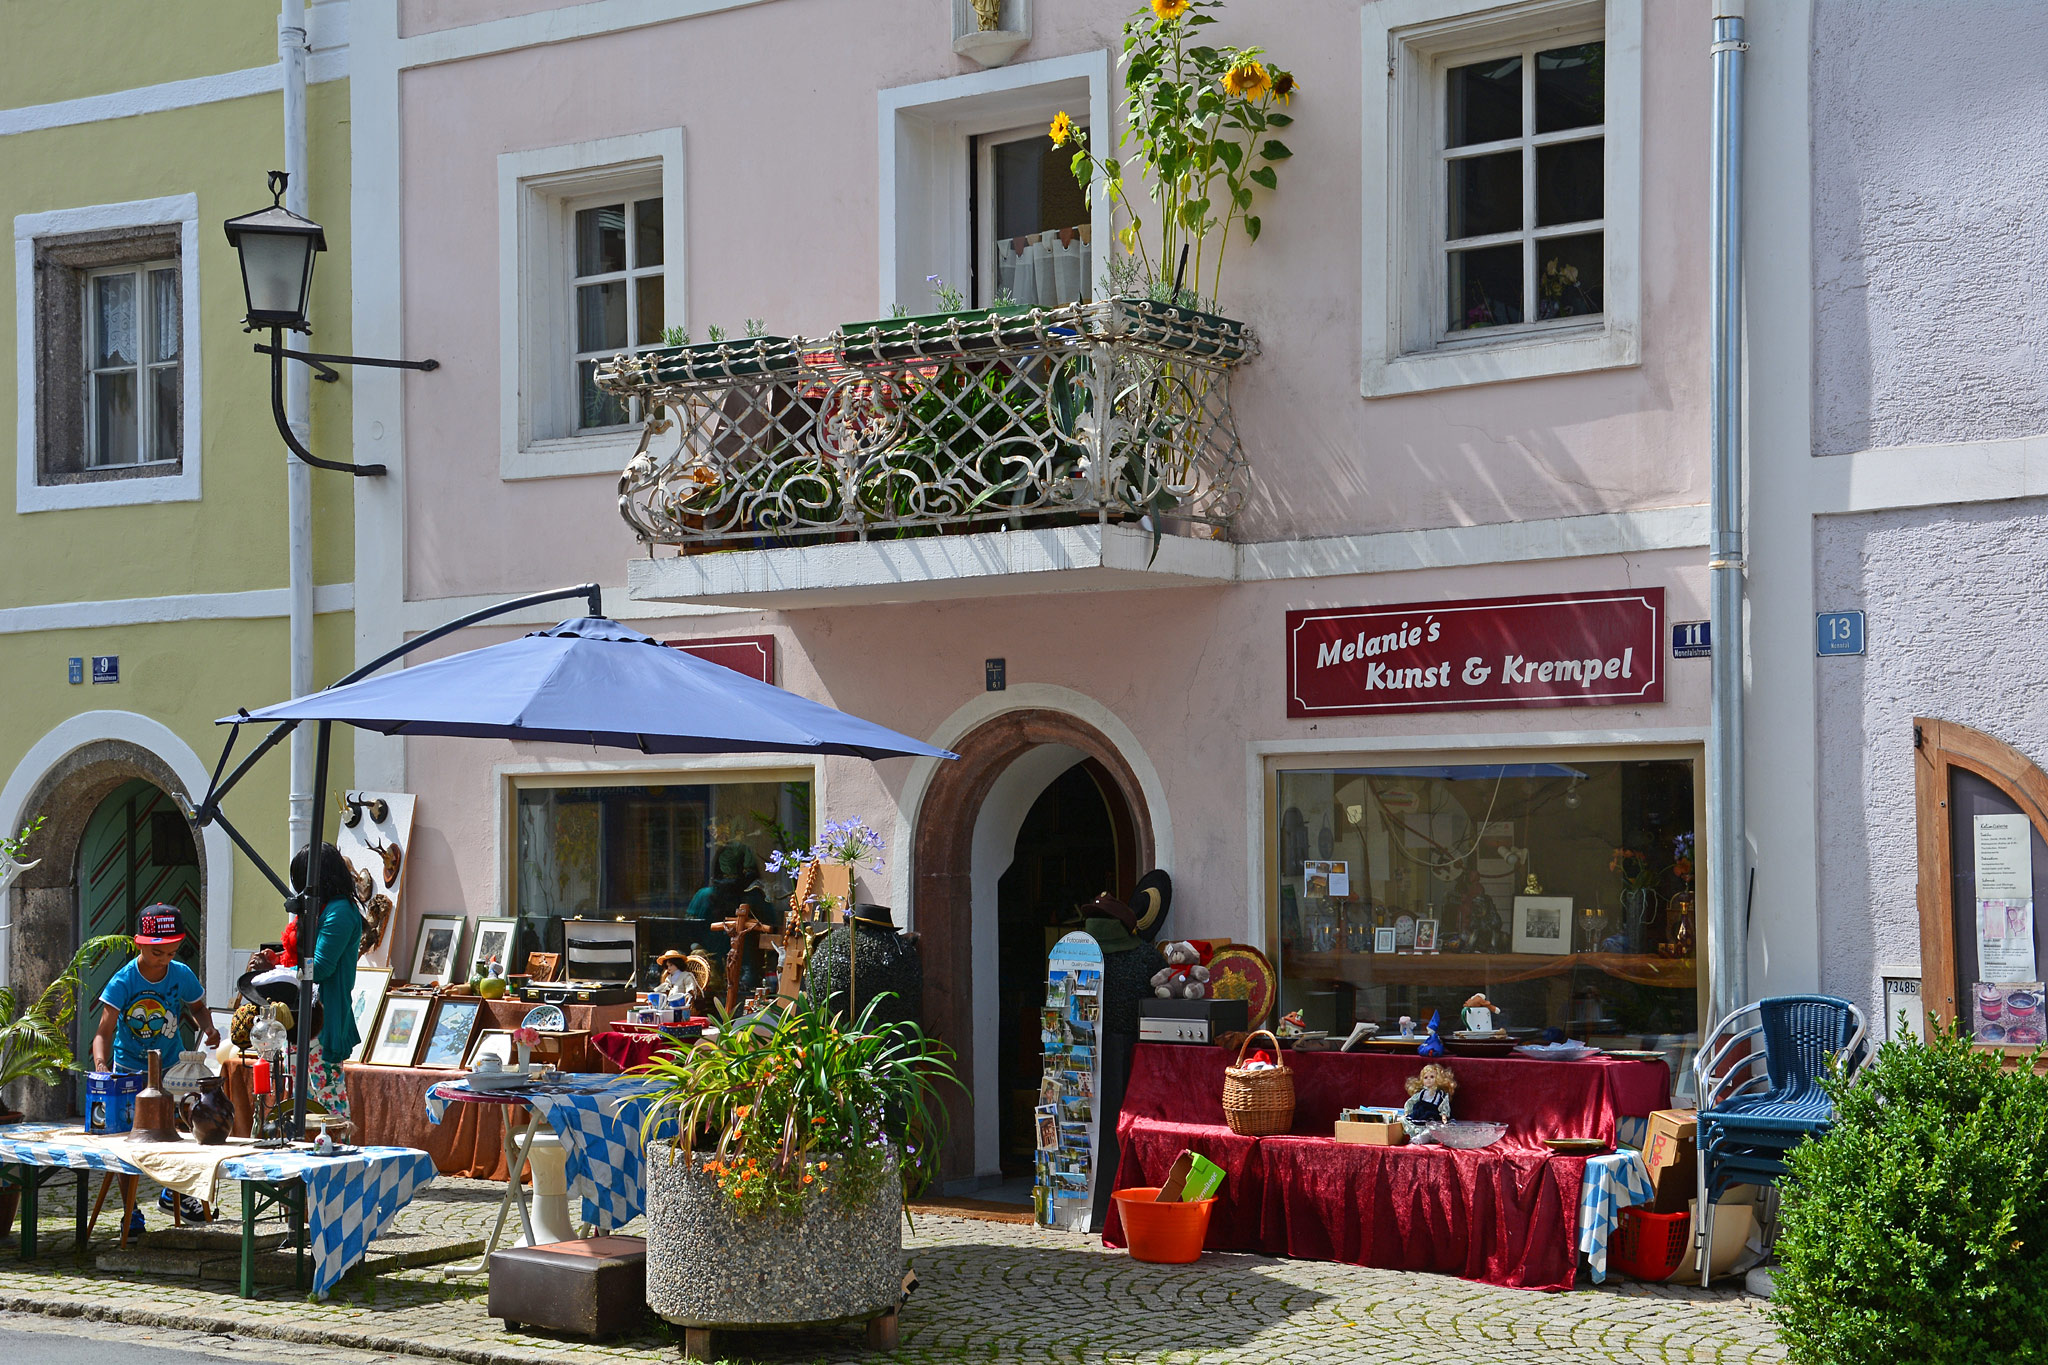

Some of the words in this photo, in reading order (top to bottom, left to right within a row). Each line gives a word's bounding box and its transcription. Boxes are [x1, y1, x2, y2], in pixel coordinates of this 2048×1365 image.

[1684, 624, 1703, 646] 11
[1829, 617, 1851, 640] 13
[100, 657, 109, 673] 9
[1365, 661, 1451, 690] Kunst
[1461, 656, 1492, 686] &
[1501, 647, 1633, 688] Krempel
[1887, 981, 1916, 993] 73486
[1651, 1135, 1667, 1166] Dole
